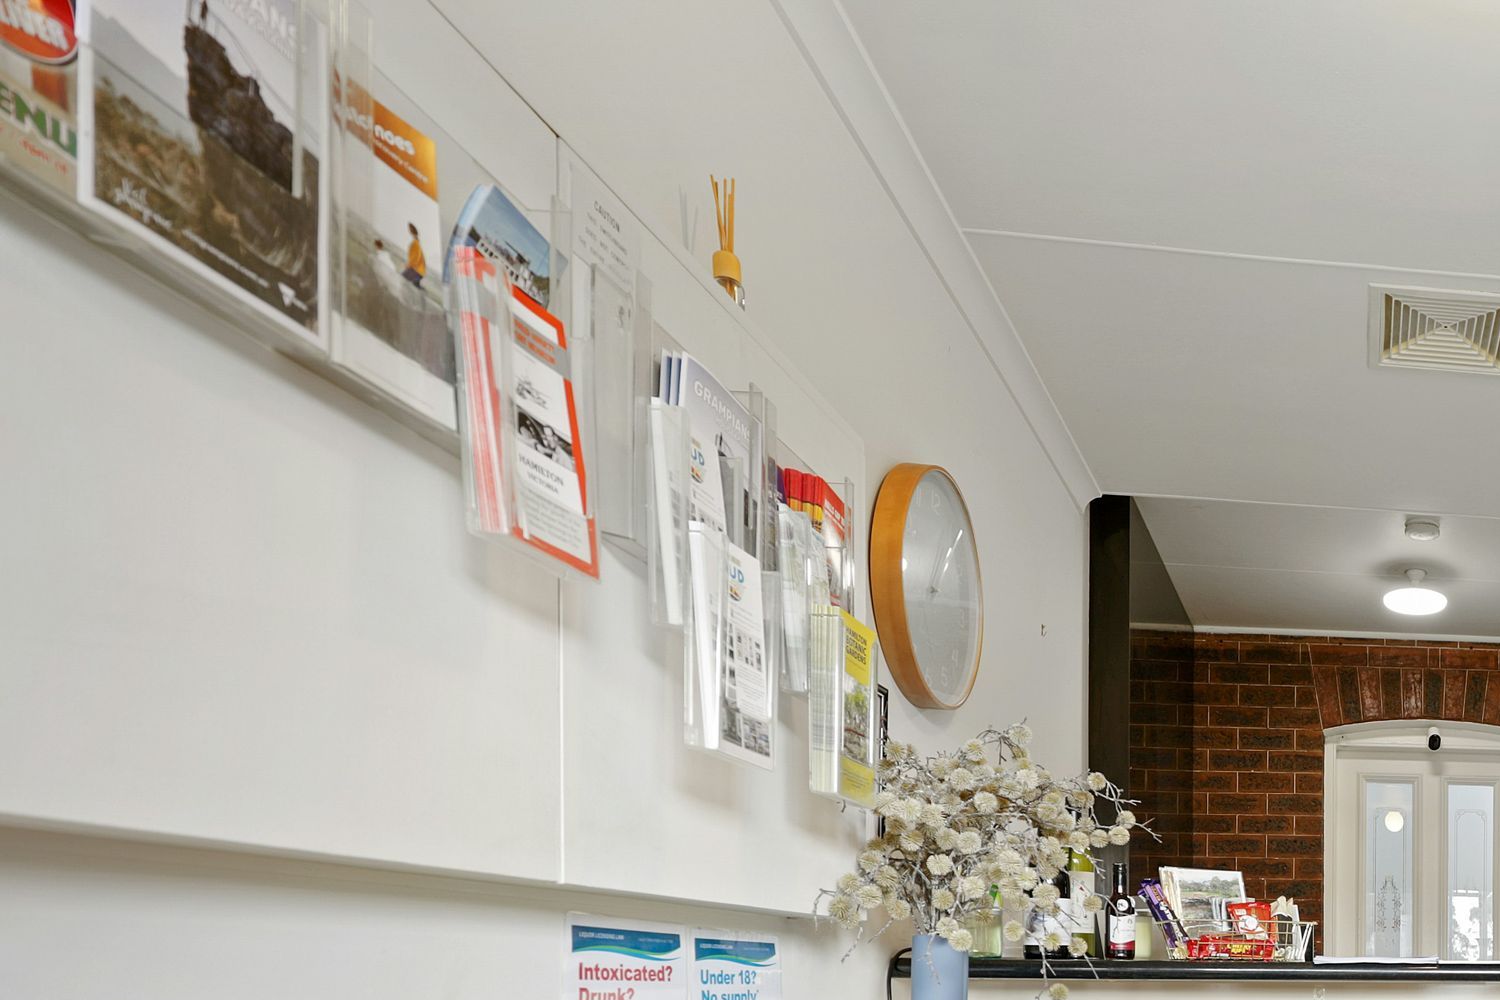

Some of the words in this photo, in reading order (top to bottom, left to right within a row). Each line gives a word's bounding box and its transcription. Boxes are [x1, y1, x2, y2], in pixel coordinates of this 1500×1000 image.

[518, 452, 564, 486] HAMILTON
[578, 961, 673, 982] Intoxicated?
[700, 969, 735, 985] Under
[738, 969, 757, 985] 18?
